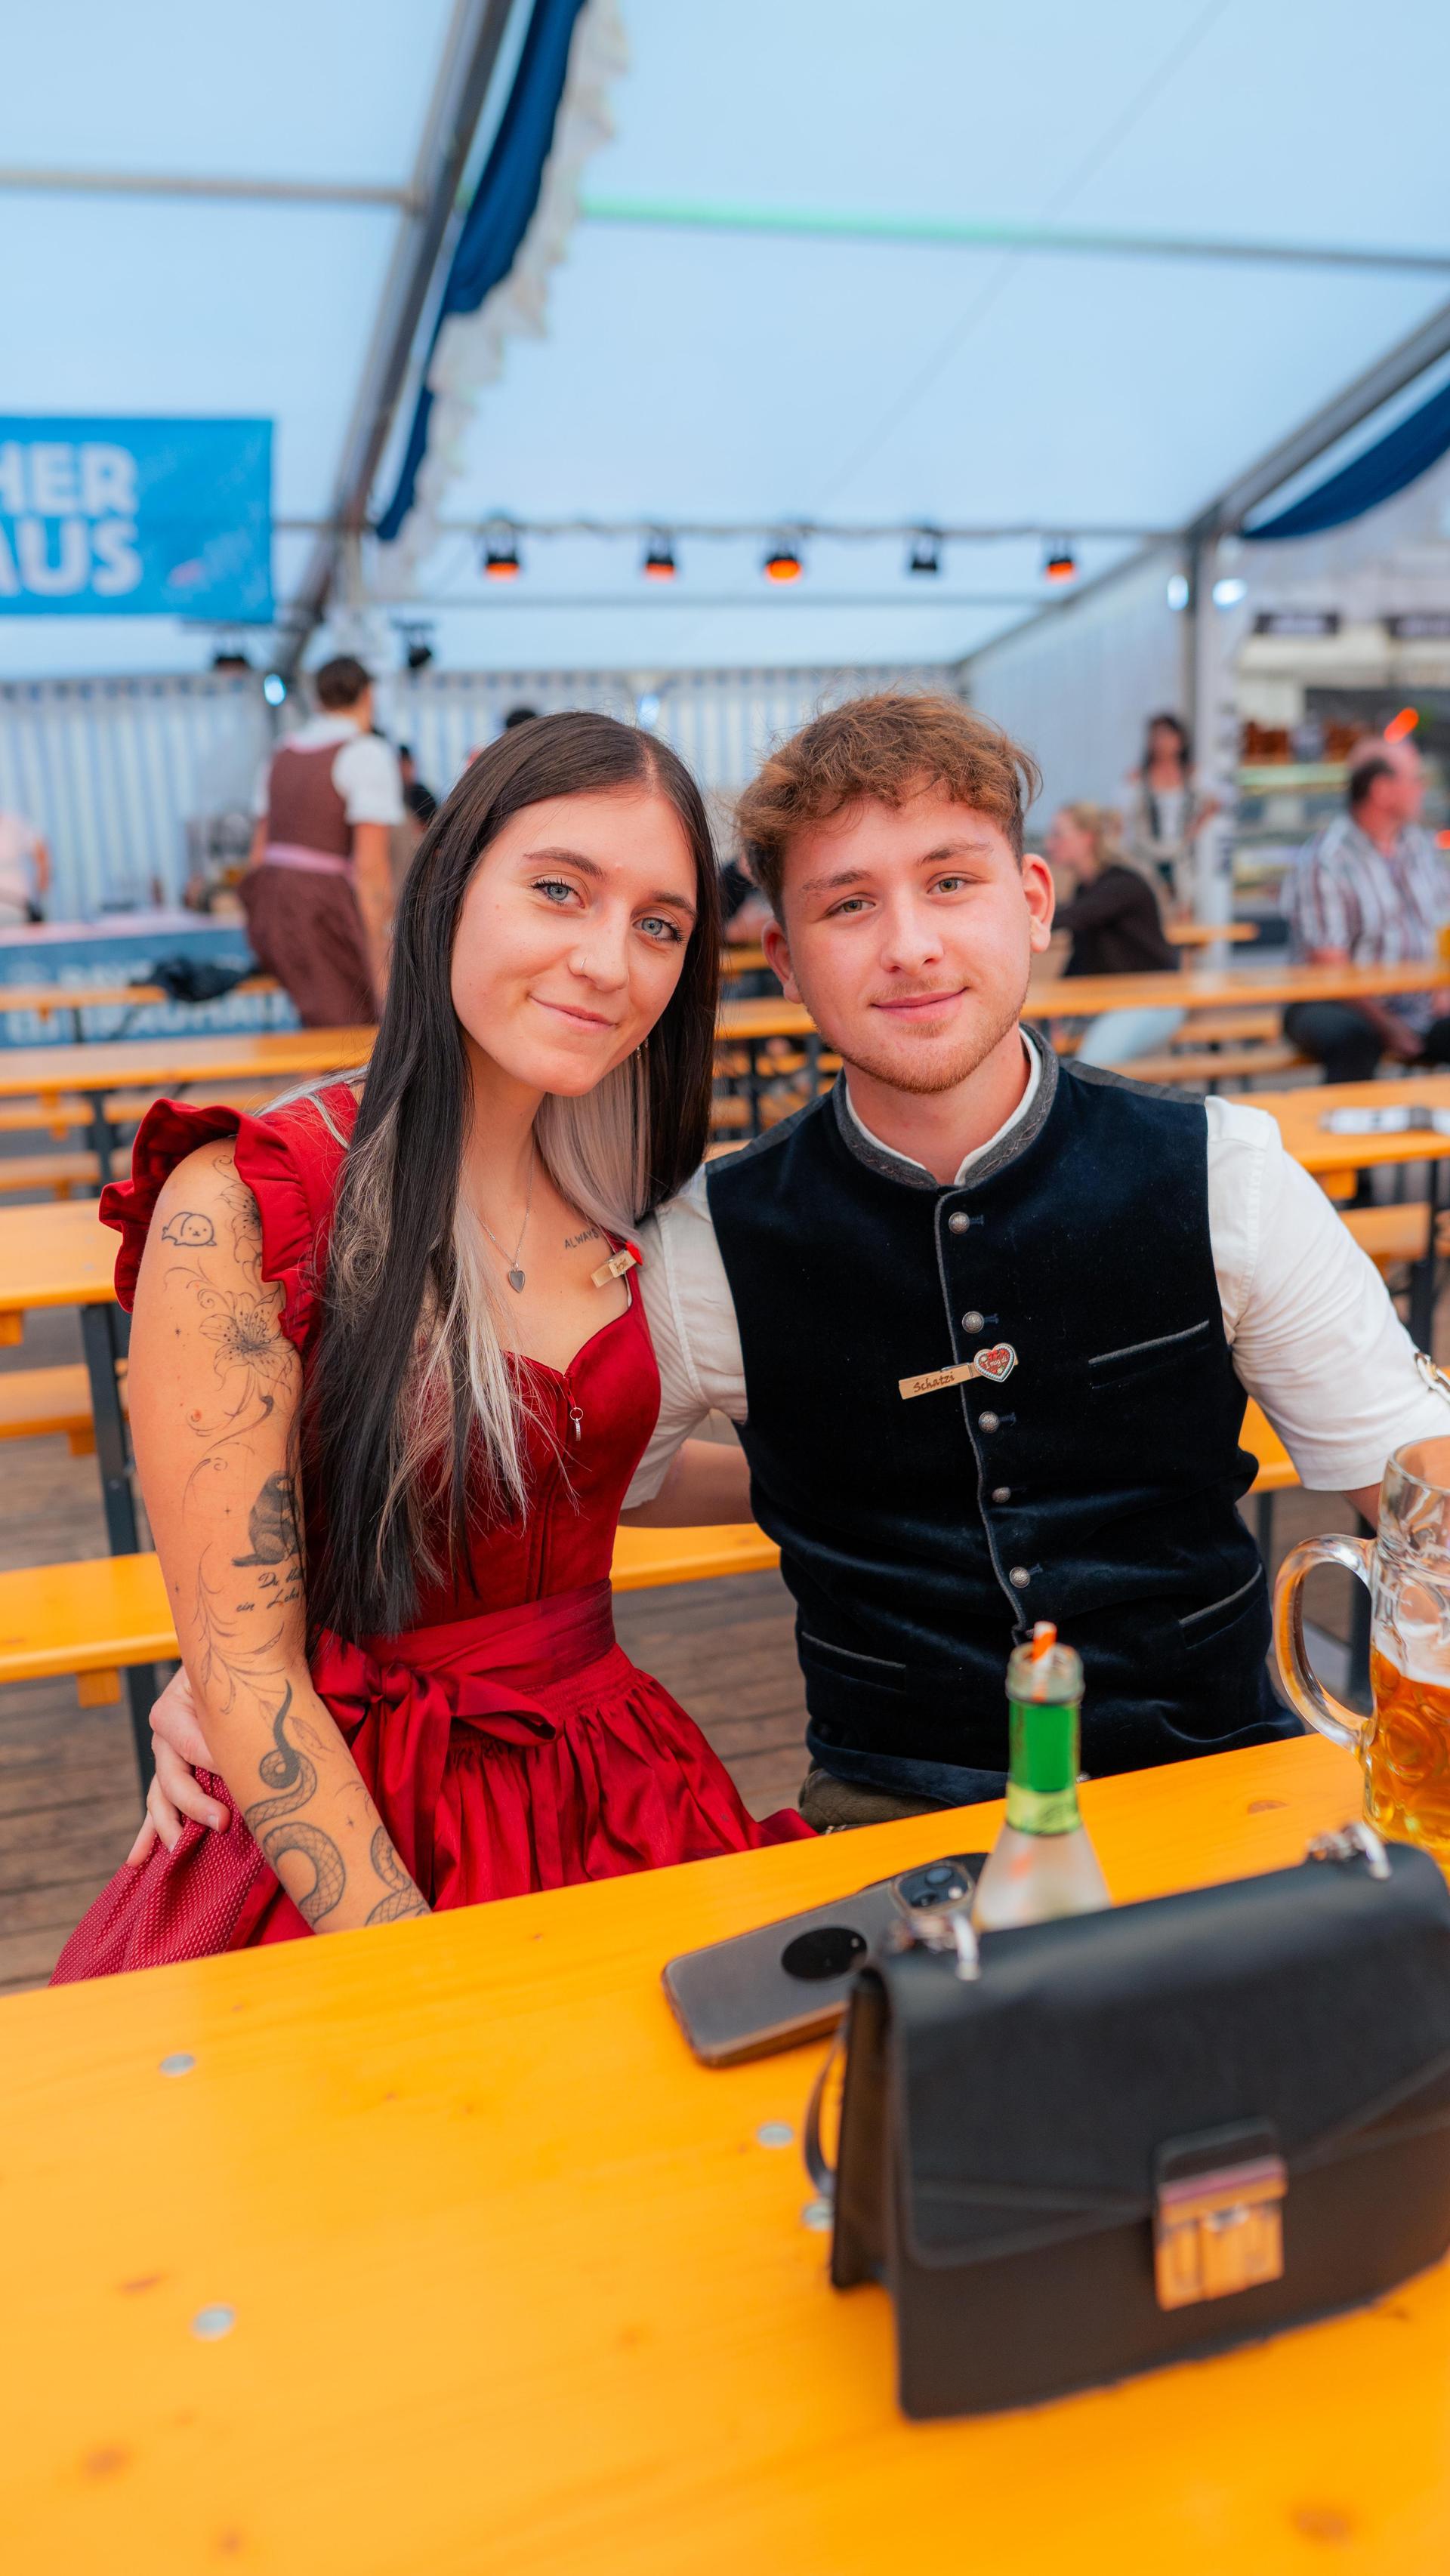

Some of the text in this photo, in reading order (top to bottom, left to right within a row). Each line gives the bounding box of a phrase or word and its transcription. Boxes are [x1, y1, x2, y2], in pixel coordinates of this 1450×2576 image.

[564, 1228, 600, 1249] ALWAYS
[990, 1359, 1001, 1367] mog
[913, 1371, 955, 1393] Schatzi
[258, 1572, 279, 1589] Du
[236, 1601, 255, 1613] ein
